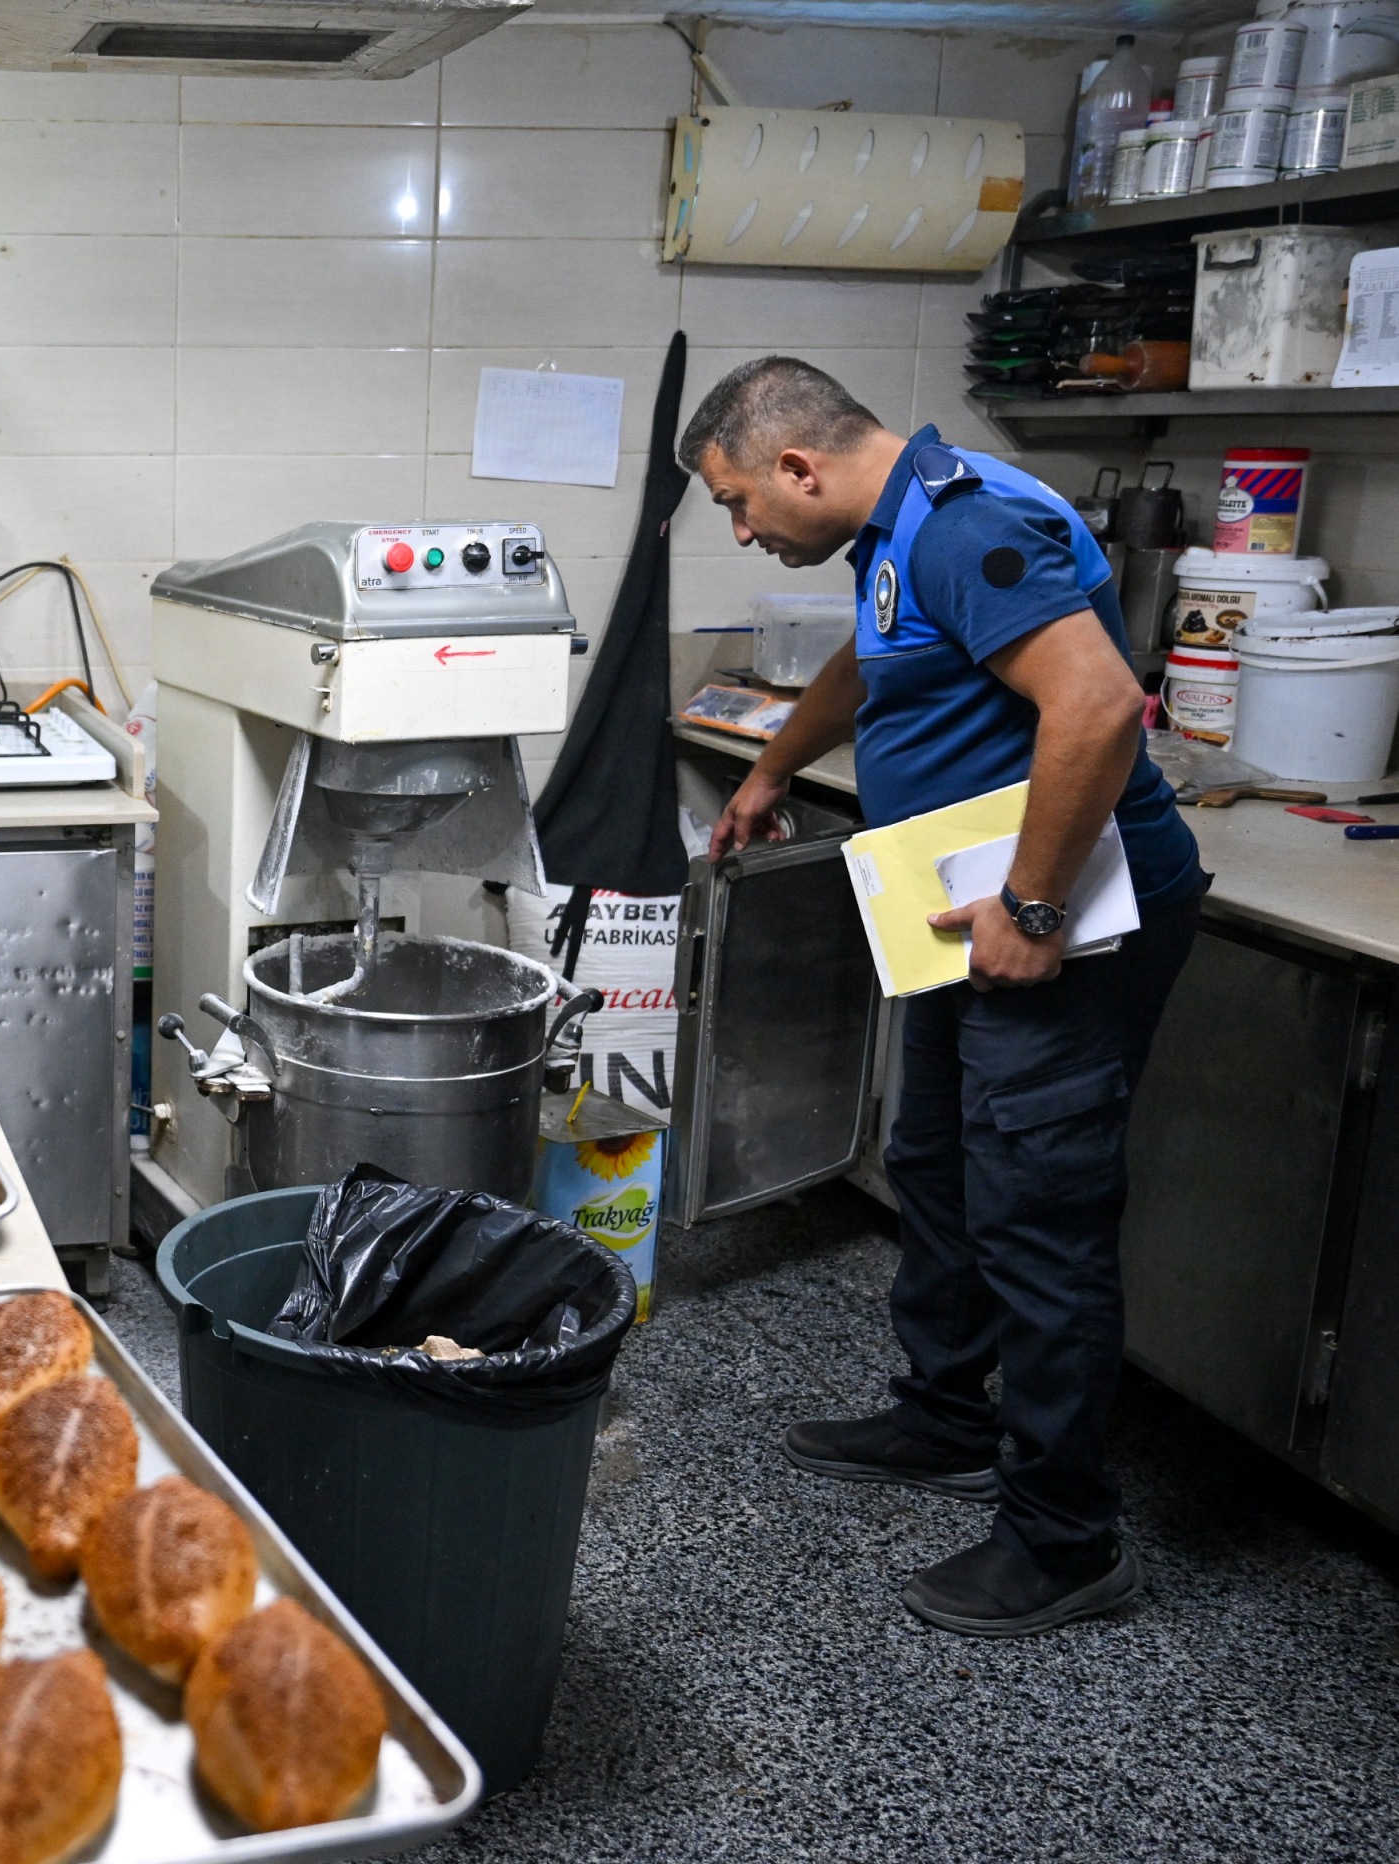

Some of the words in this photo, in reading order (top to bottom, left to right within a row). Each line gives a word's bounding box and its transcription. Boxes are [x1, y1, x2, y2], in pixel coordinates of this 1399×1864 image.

[421, 529, 440, 537] START
[467, 528, 483, 536] TIMR
[361, 577, 382, 586] atra
[546, 904, 676, 921] AAYBEY
[572, 1201, 656, 1230] Trakyağ
